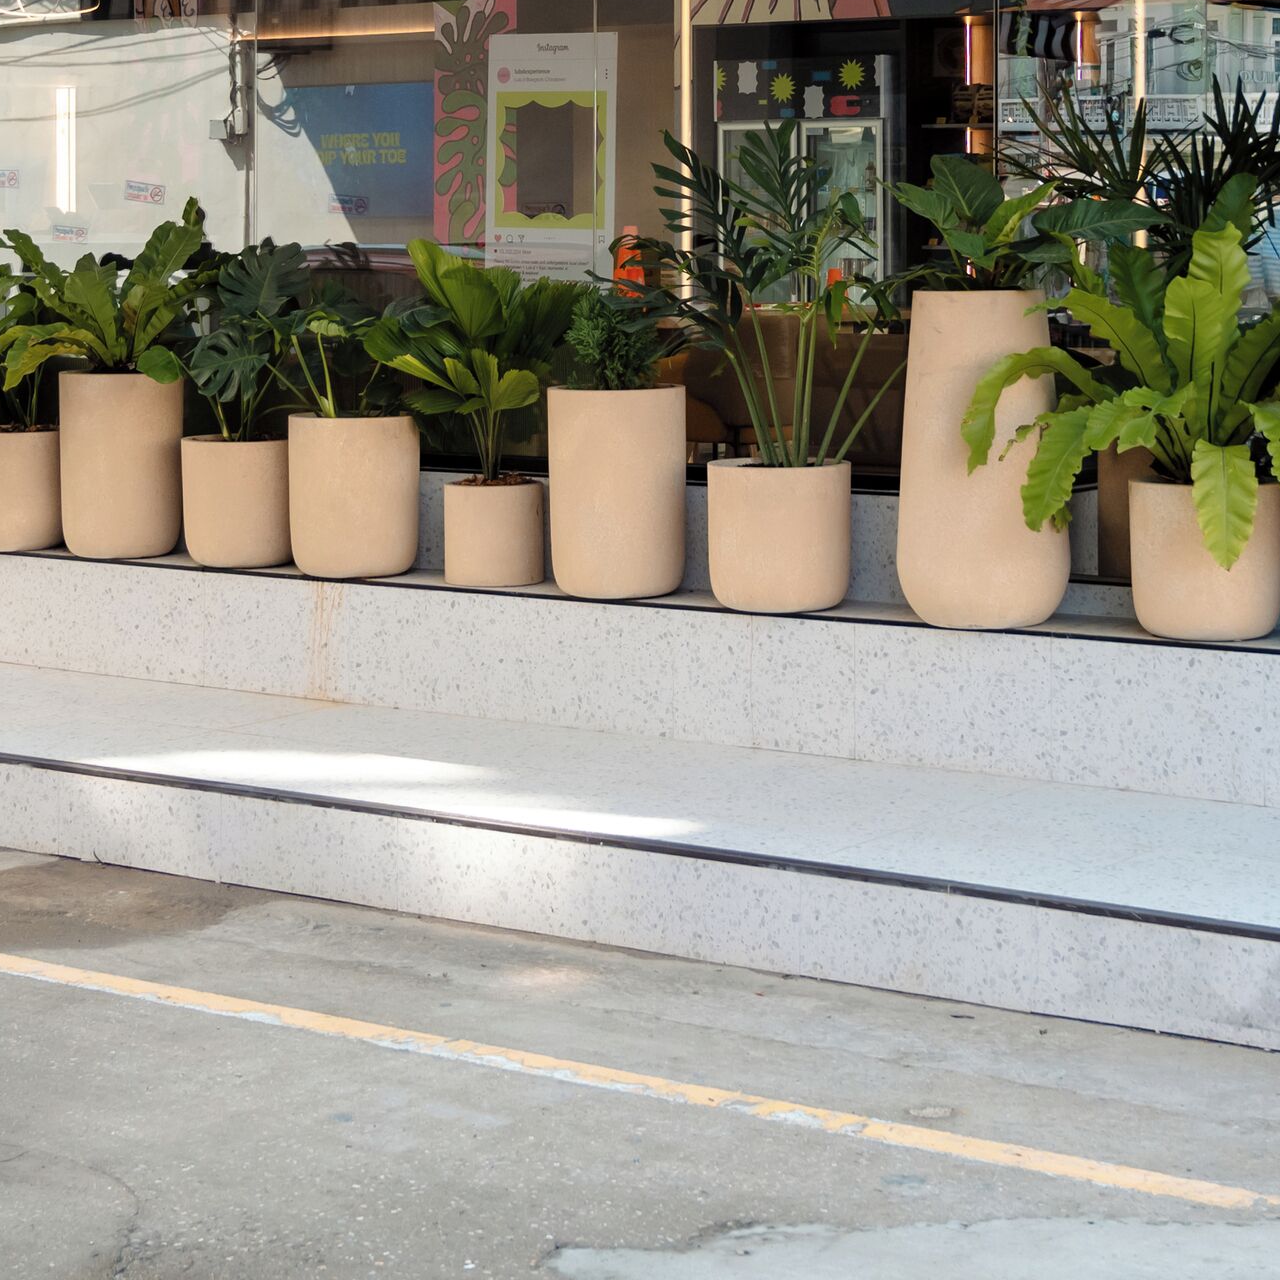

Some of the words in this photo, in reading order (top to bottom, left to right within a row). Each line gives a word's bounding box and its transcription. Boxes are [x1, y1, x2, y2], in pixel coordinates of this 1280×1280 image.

[320, 133, 369, 148] WHERE
[372, 132, 400, 147] YOU
[381, 149, 407, 164] TOE
